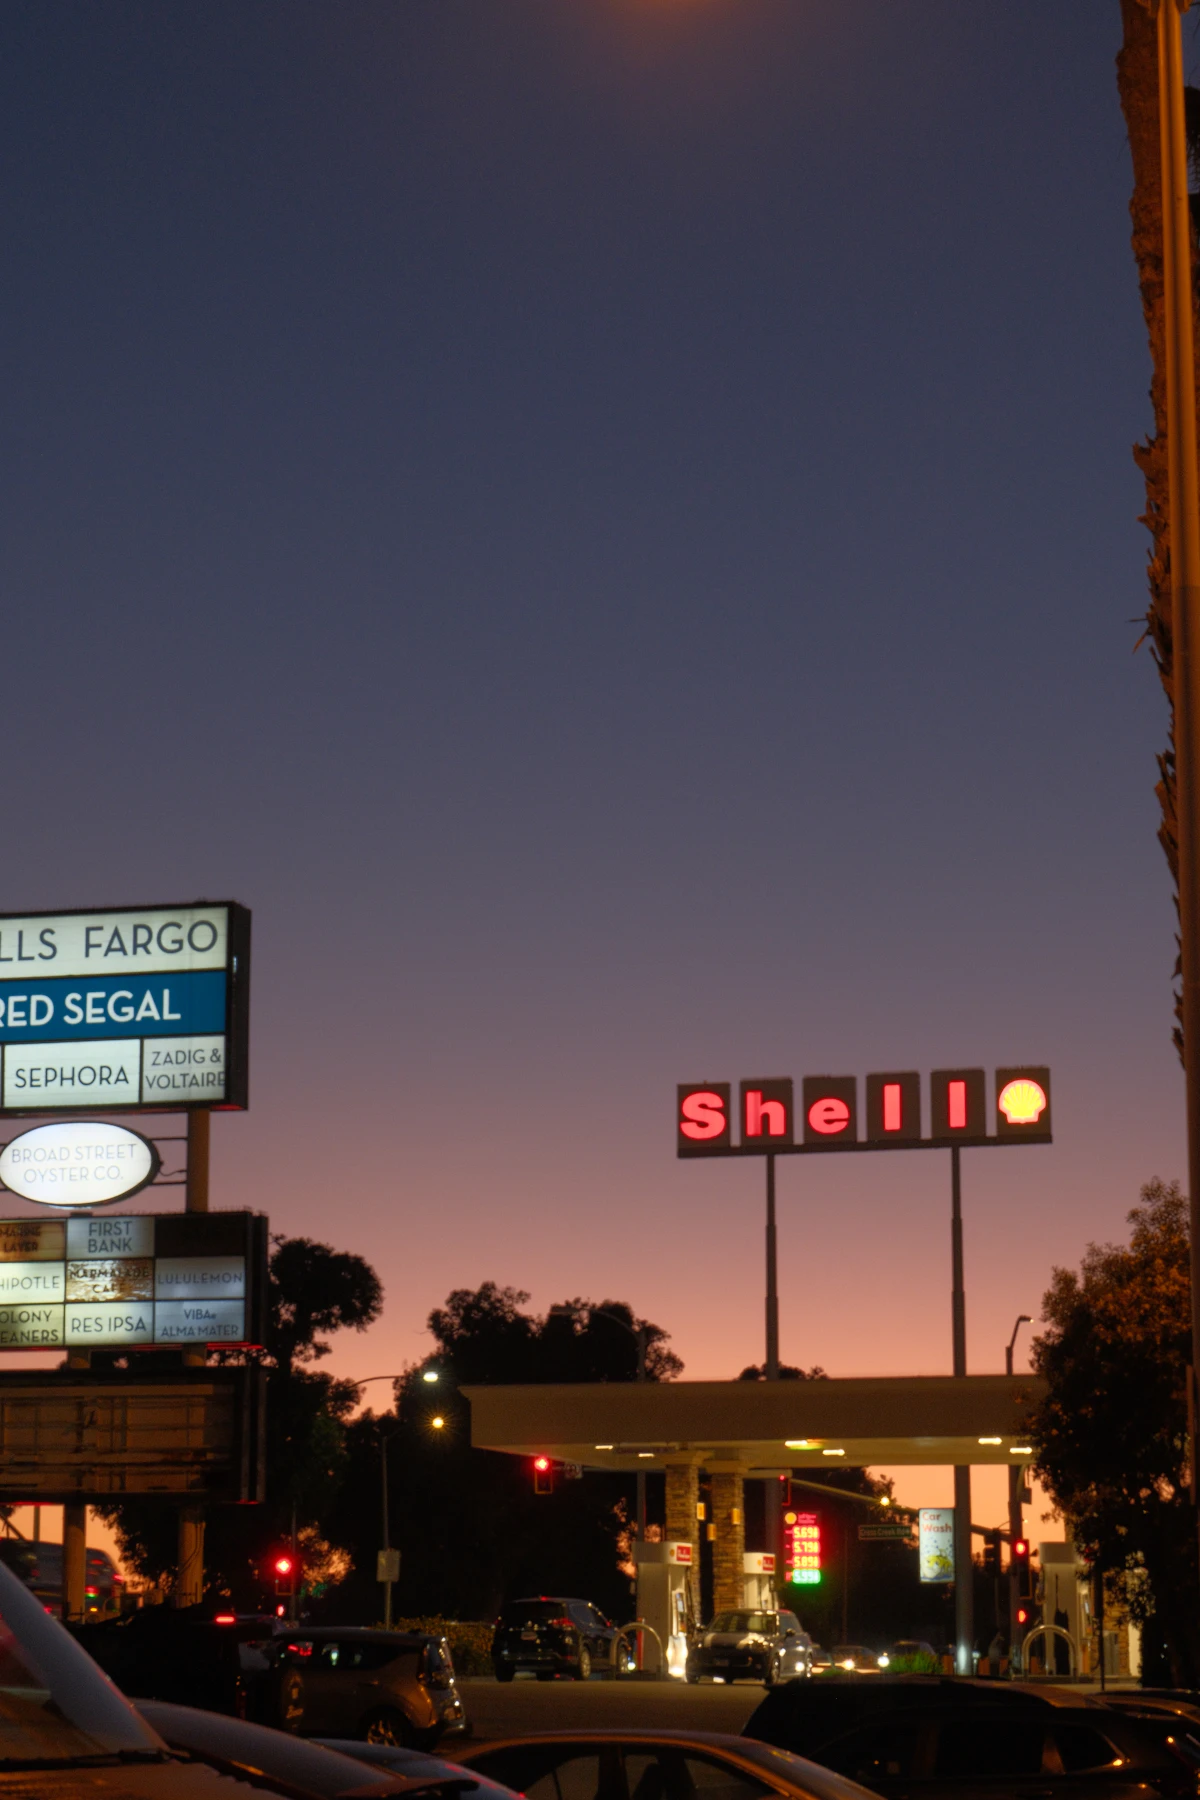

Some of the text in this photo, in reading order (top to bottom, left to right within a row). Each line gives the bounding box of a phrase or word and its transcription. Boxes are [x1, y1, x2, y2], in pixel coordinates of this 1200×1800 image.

[85, 920, 218, 957] FARGO
[0, 988, 181, 1027] ED SEGAL
[152, 1048, 222, 1066] ZADIG &
[15, 1065, 129, 1088] SEPHORA
[146, 1071, 225, 1089] VOLTAIRE
[680, 1081, 966, 1140] Shell
[12, 1143, 137, 1163] BROAD STREET
[24, 1165, 124, 1183] OYSTER CO.
[89, 1221, 132, 1236] FIRST
[88, 1237, 132, 1253] BANK
[158, 1272, 243, 1284] LULULEMON
[72, 1315, 146, 1333] RES IPSA
[161, 1324, 239, 1337] ALMA MATER
[922, 1511, 941, 1521] Car
[922, 1523, 952, 1533] Wash
